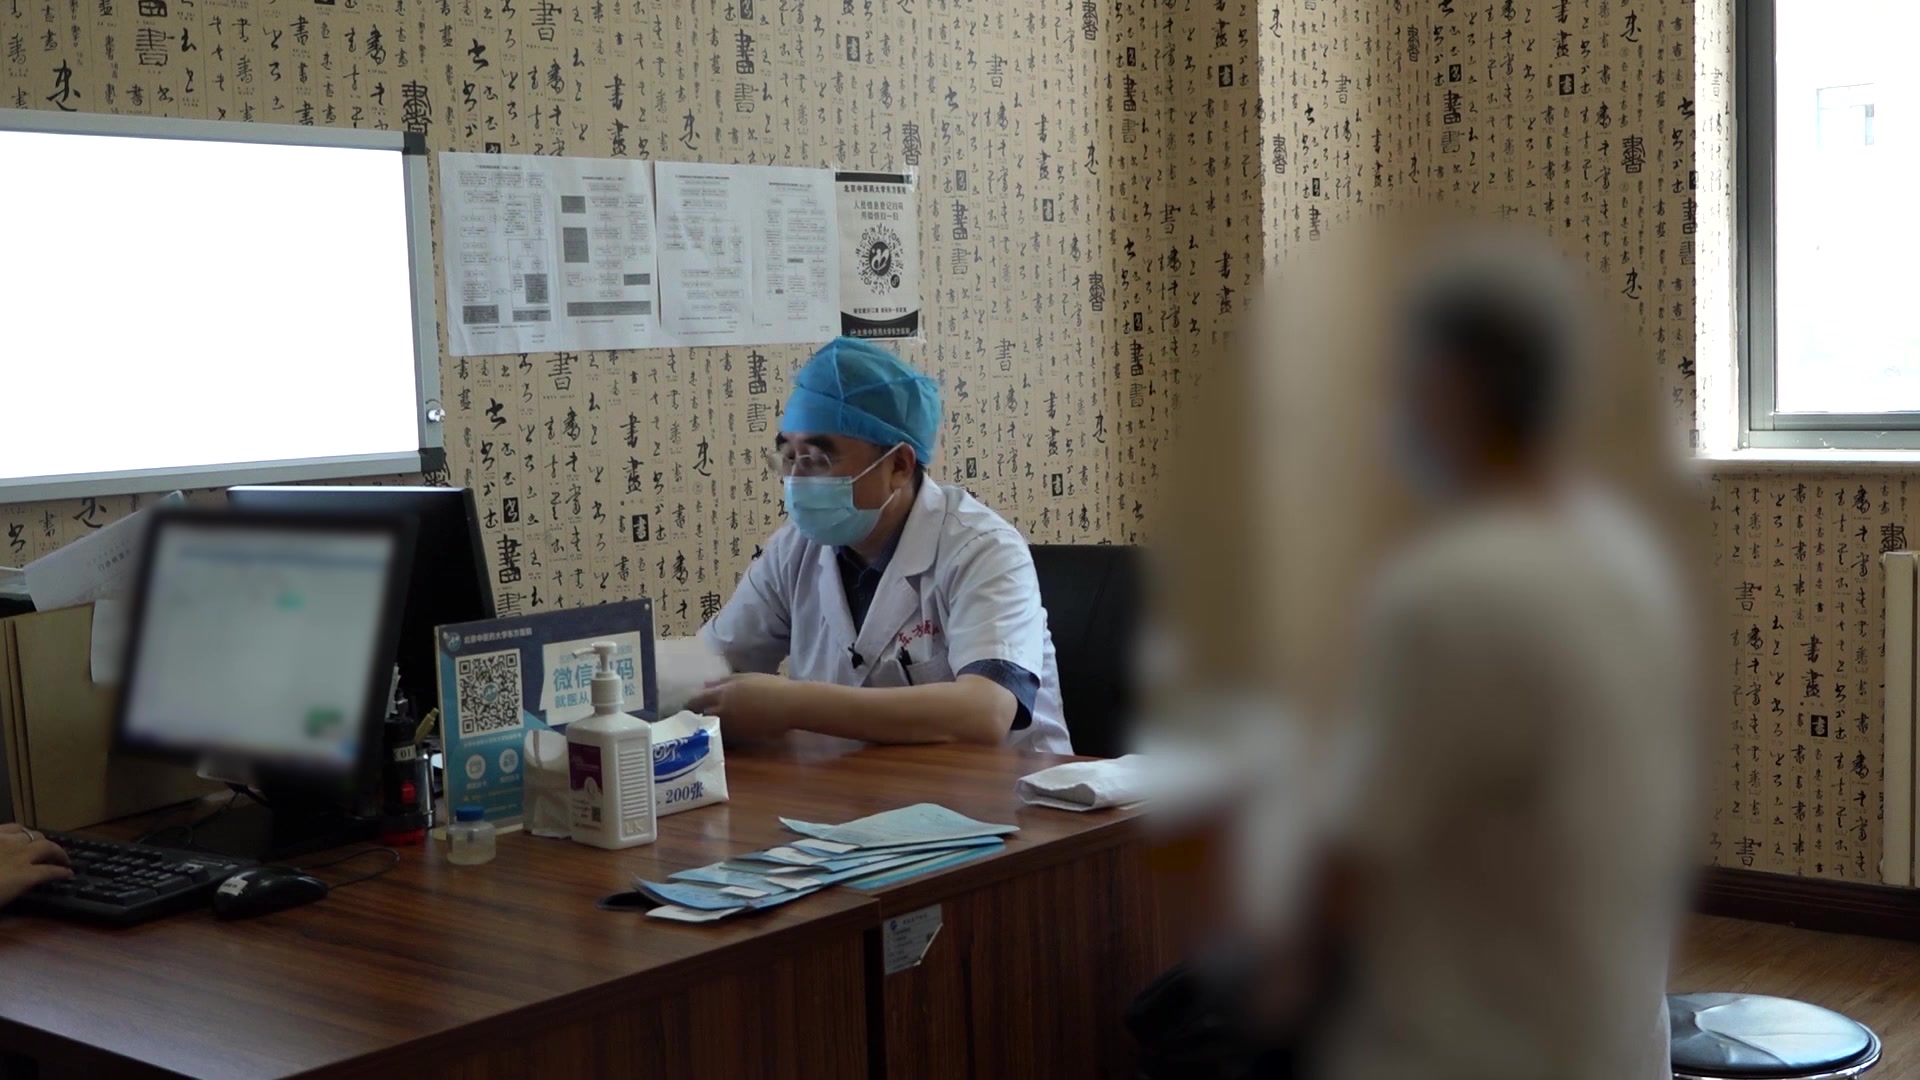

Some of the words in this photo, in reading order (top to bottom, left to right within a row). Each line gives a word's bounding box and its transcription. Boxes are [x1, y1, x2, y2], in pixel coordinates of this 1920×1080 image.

[555, 684, 635, 708] 就医从松
[665, 780, 704, 804] 200张
